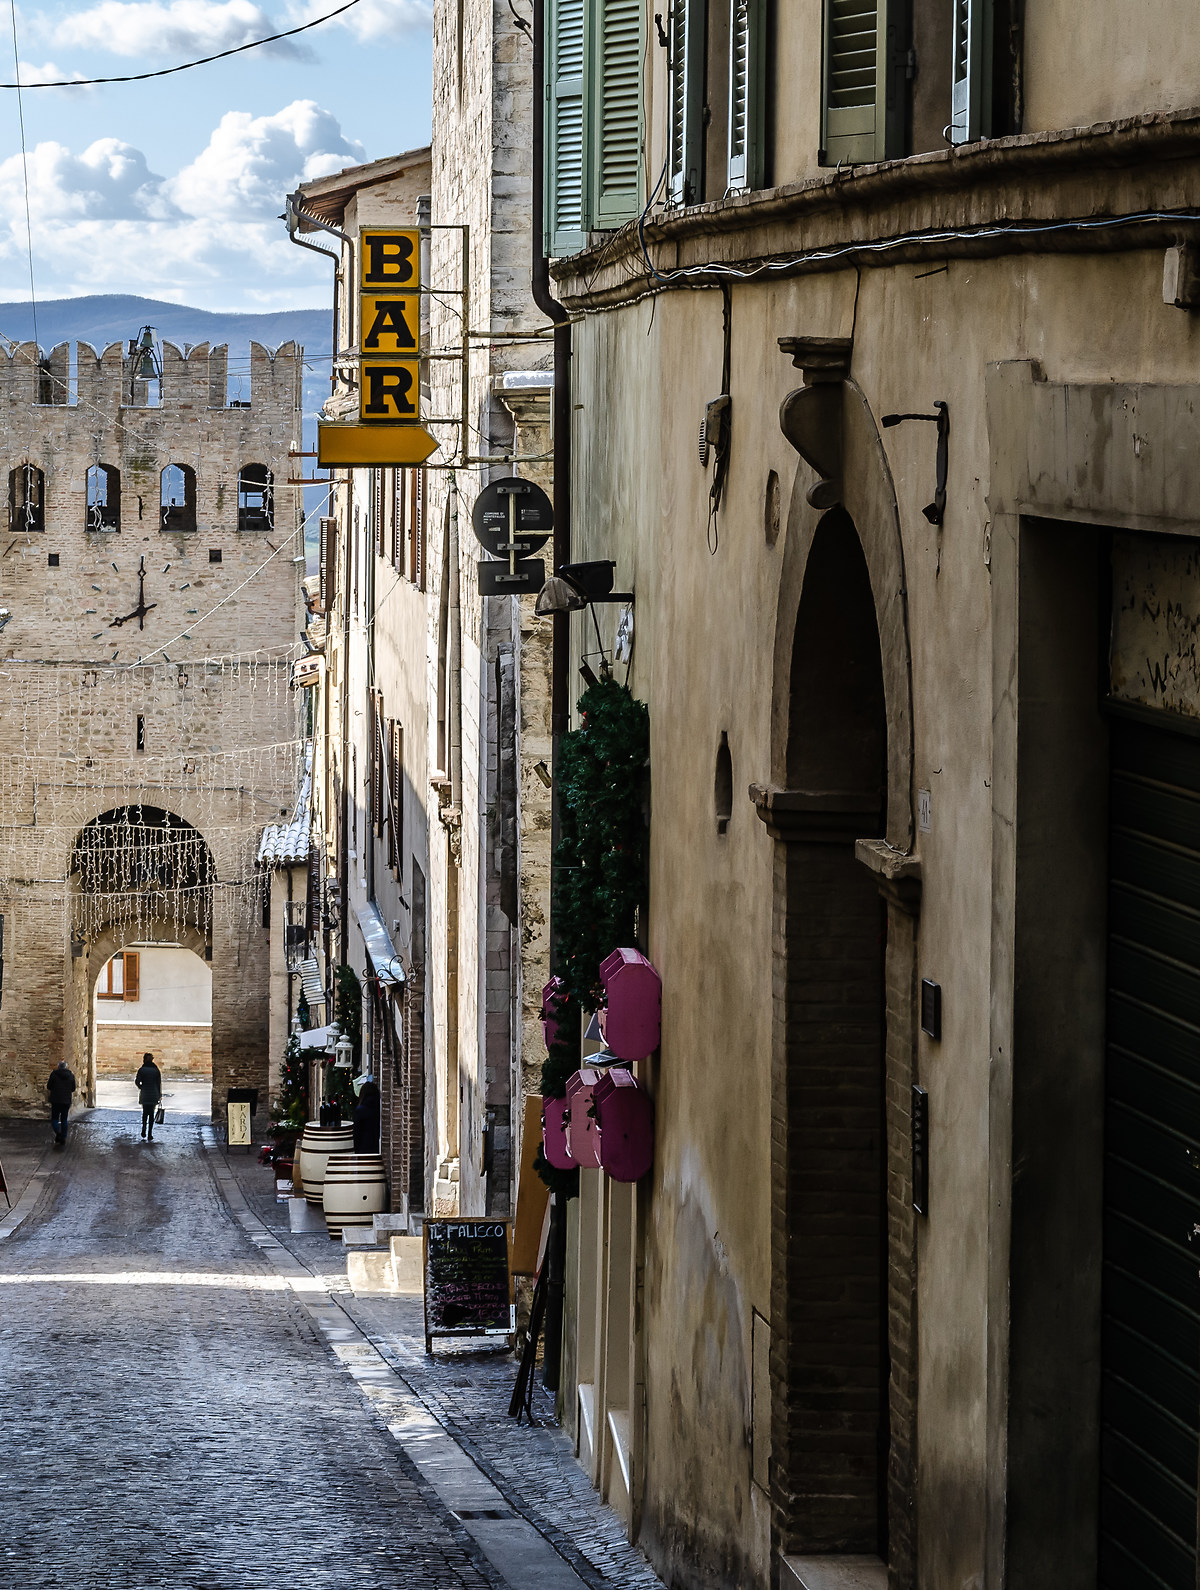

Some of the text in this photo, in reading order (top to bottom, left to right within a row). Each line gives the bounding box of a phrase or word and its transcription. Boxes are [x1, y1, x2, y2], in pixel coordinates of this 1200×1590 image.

[365, 235, 416, 413] BAR
[430, 1224, 504, 1240] IL FALISCO
